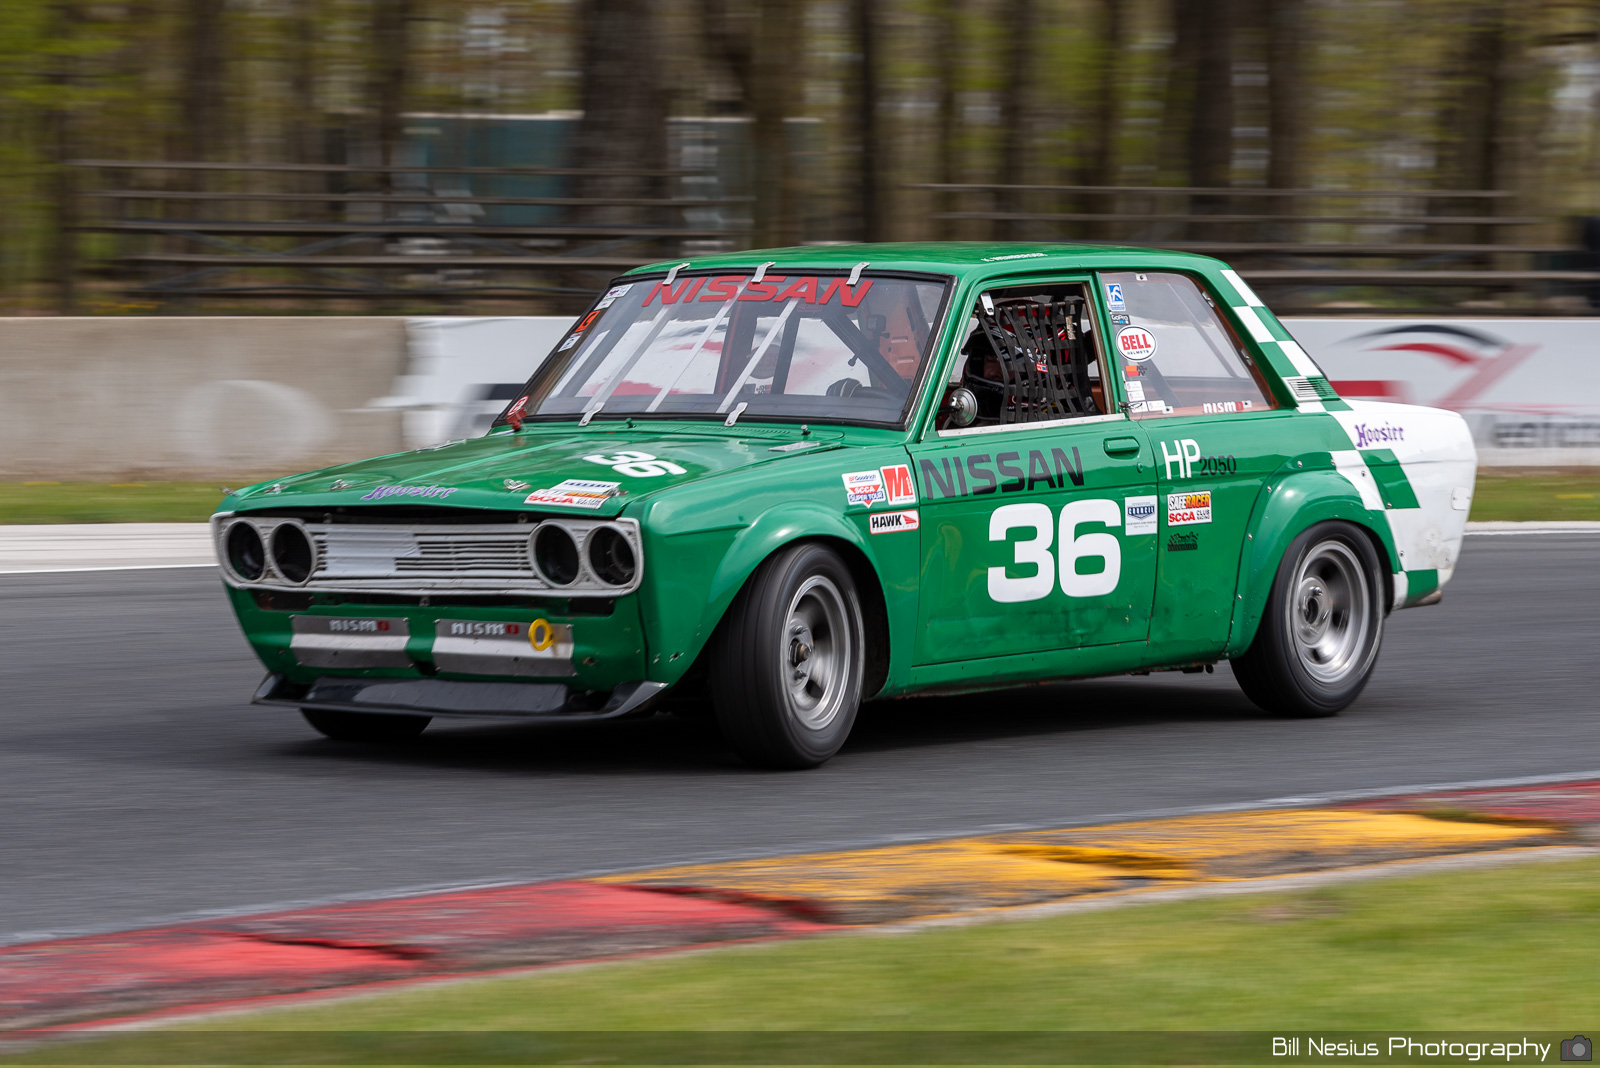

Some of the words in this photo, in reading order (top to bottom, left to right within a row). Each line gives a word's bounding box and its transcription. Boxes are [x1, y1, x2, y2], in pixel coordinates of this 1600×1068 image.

[641, 275, 874, 307] NISSAN
[1121, 334, 1151, 351] BELL
[582, 450, 688, 478] 36
[1160, 439, 1200, 480] HP
[1199, 455, 1237, 476] 2050
[919, 446, 1085, 500] NISSAN
[849, 494, 868, 502] SUPER
[868, 491, 884, 500] TOUR
[854, 486, 875, 494] SCCA
[529, 495, 574, 504] SCCA
[872, 514, 902, 528] HAWK
[1168, 511, 1196, 523] SCCA
[987, 499, 1122, 603] 36
